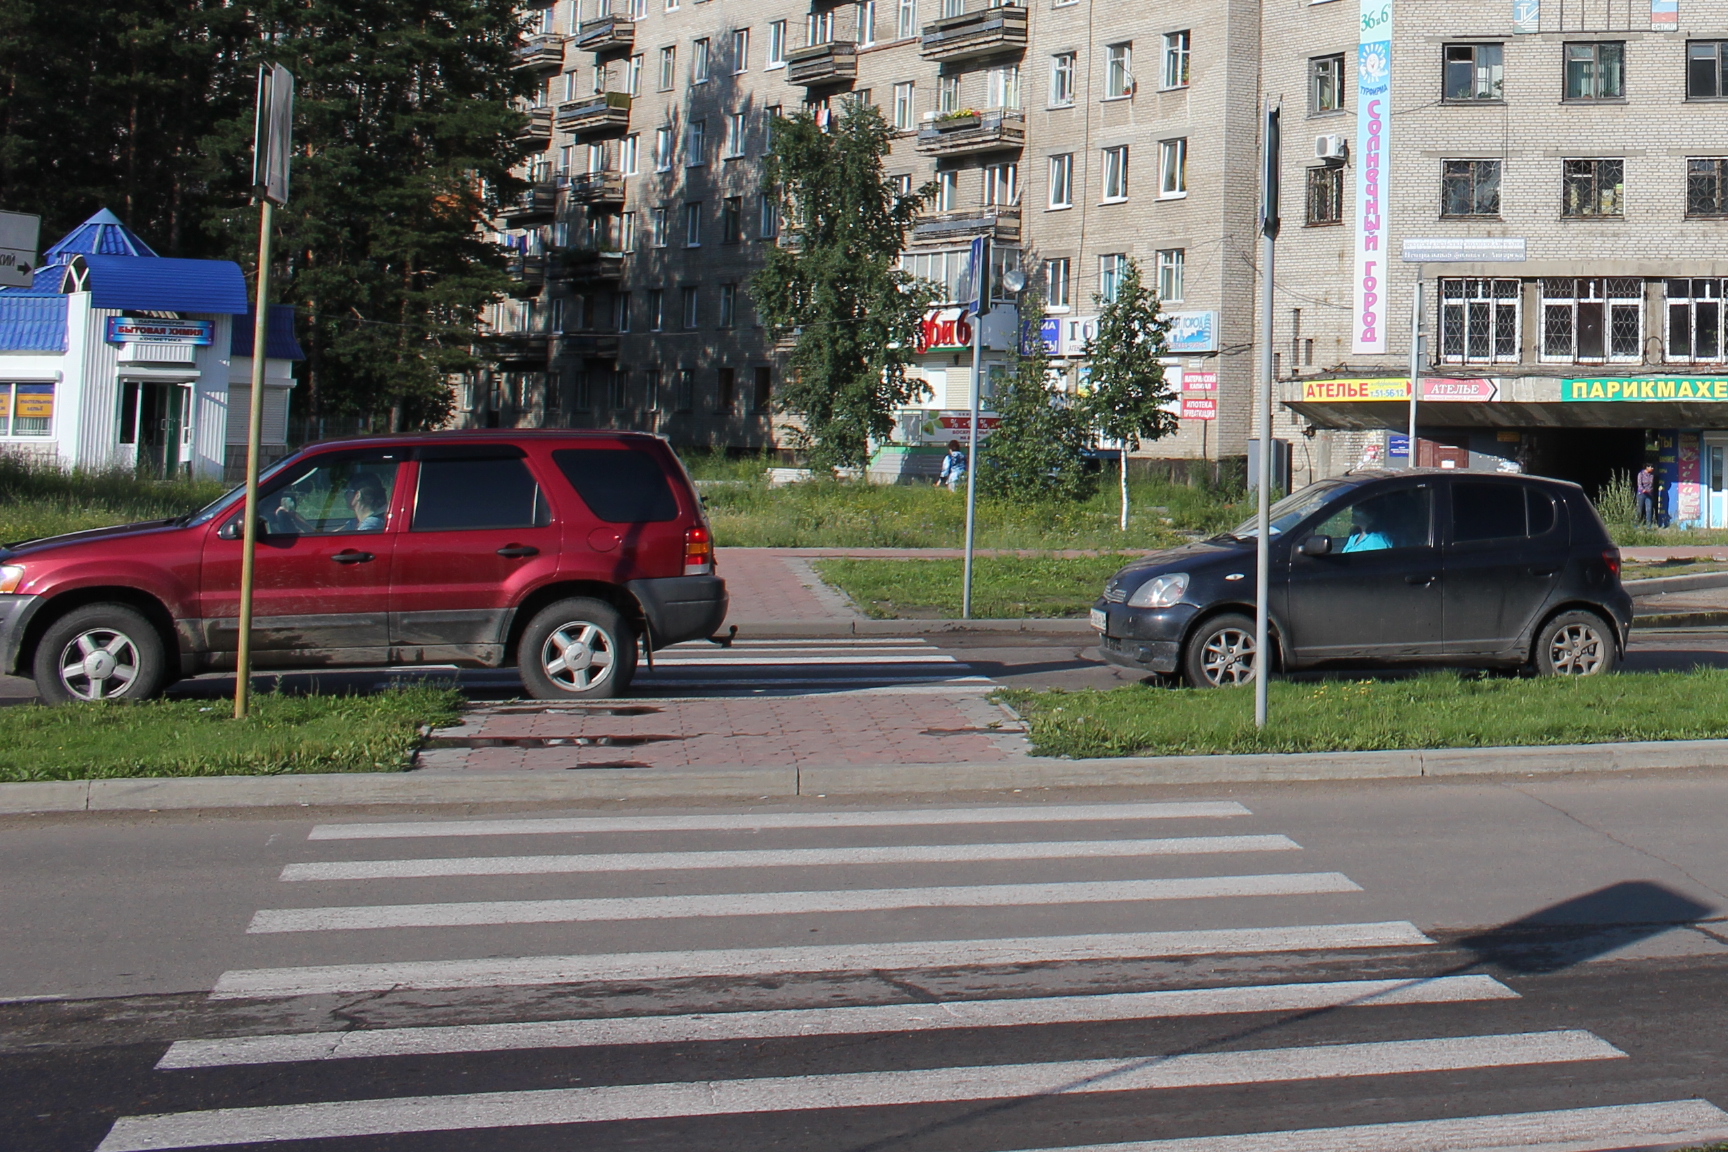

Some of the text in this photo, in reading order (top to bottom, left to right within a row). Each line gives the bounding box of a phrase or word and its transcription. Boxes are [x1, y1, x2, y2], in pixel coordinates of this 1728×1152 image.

[1360, 84, 1388, 96] ТУРФИРМА
[117, 326, 204, 336] БЫТОВАЯ ХИМИЯ
[1306, 383, 1369, 398] АТЕЛЬЕ
[1431, 384, 1480, 394] АТЕЛЬЕ
[1186, 400, 1213, 408] ИПОТЕКА
